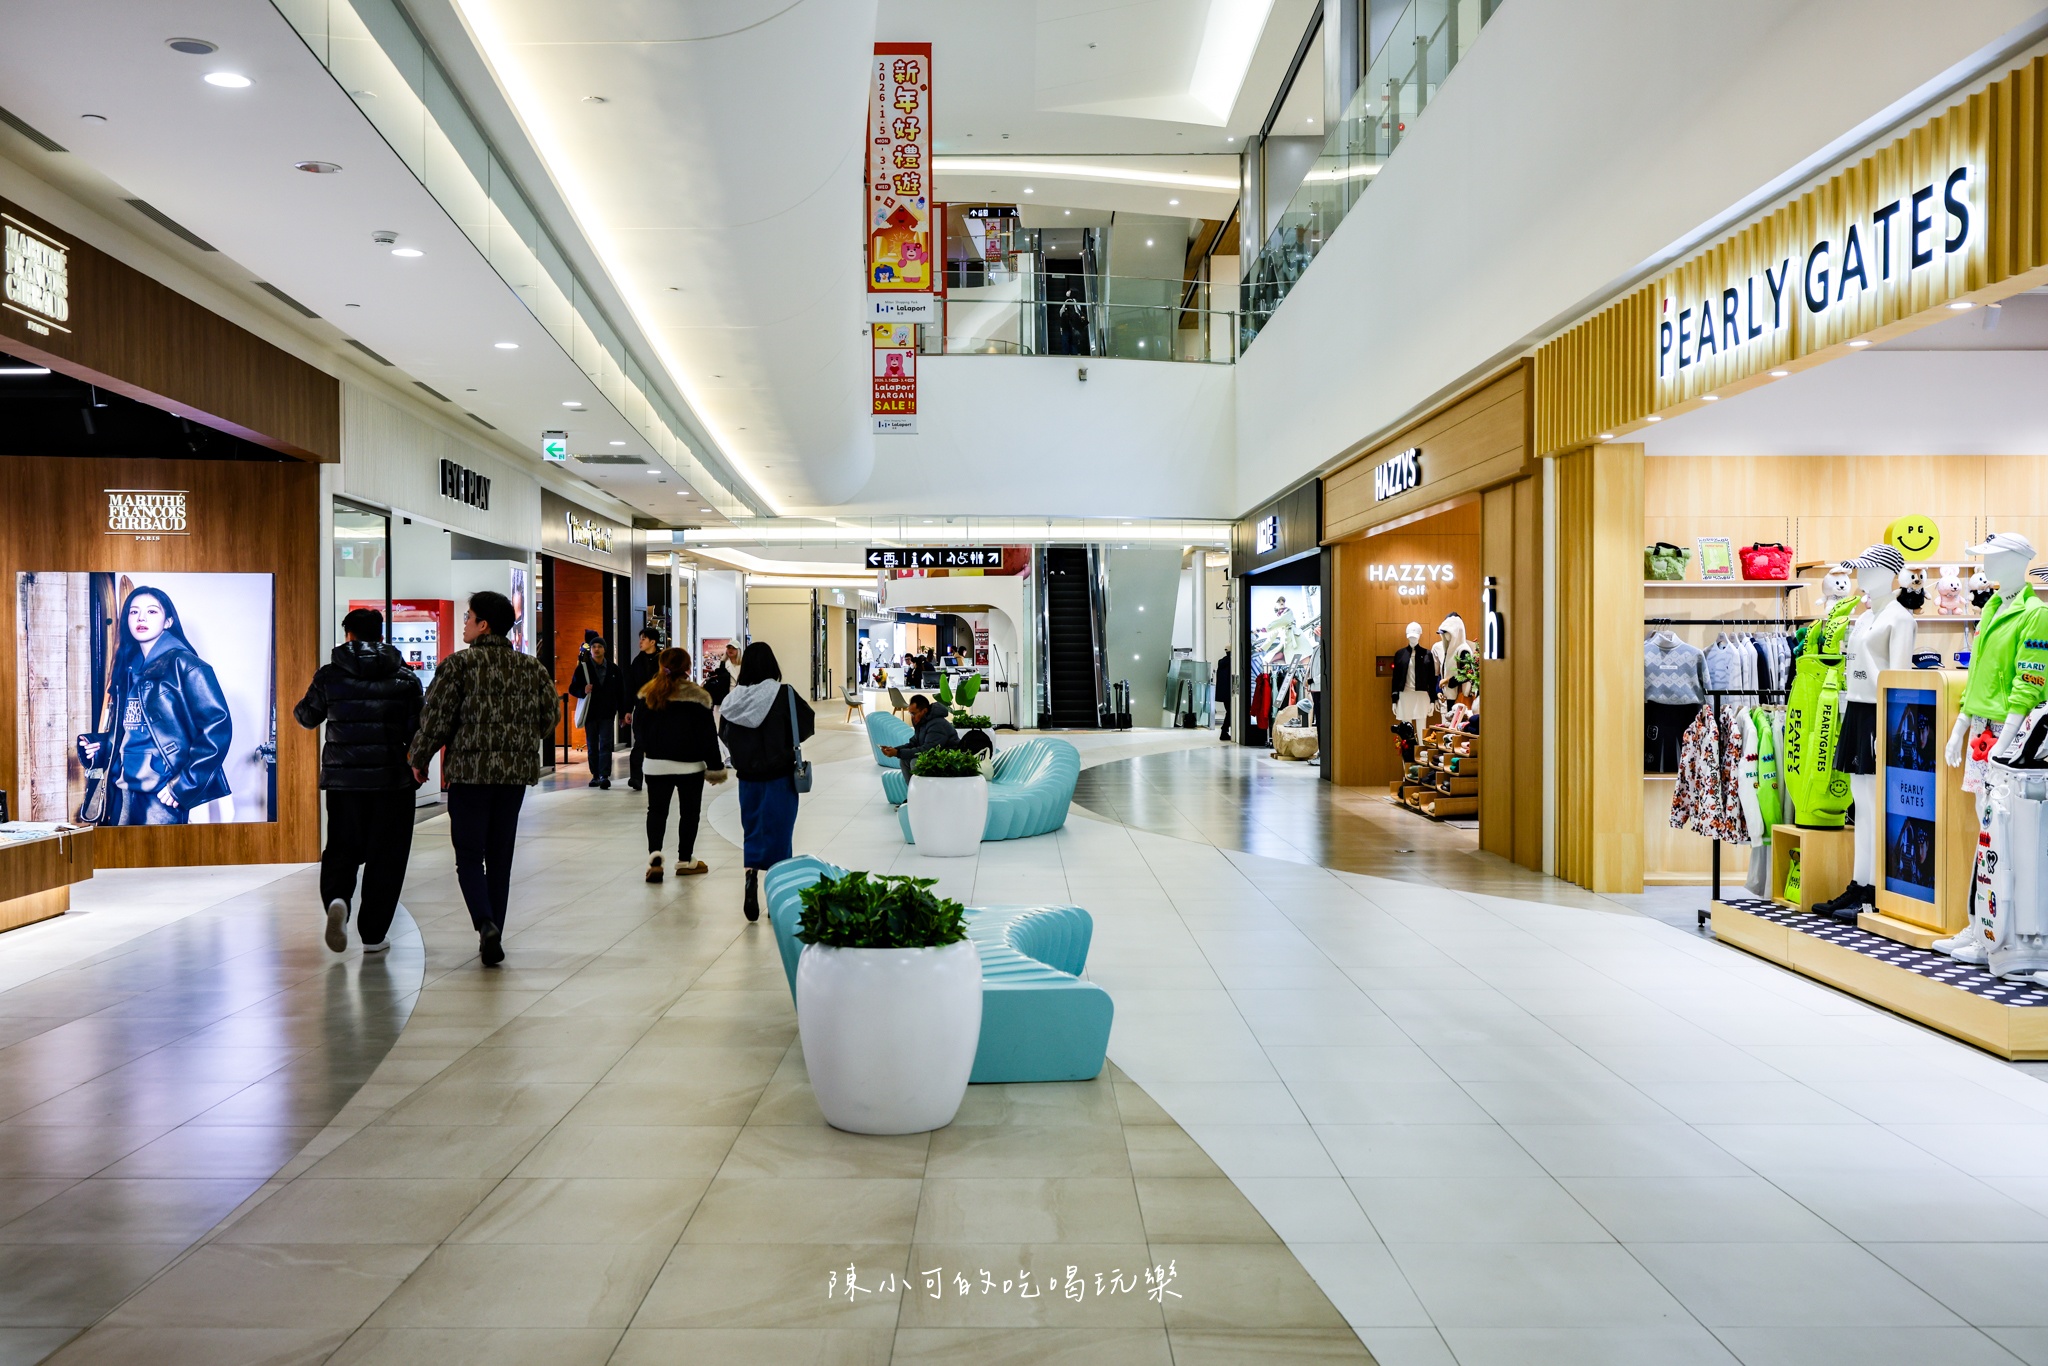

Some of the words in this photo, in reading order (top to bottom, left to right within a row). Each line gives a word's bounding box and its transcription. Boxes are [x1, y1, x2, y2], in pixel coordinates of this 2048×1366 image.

[892, 58, 921, 196] 新年好禮遊
[1660, 258, 1791, 378] PEARLY
[1804, 165, 1970, 314] GATES
[875, 400, 905, 410] SALE
[1375, 447, 1421, 502] HAZZYS
[440, 458, 464, 501] EYE
[463, 468, 491, 511] PLAY
[108, 493, 186, 506] MARITHÉ
[108, 517, 187, 531] GIRBAUD
[1369, 564, 1454, 581] HAZZYS
[1399, 585, 1426, 596] Golf
[2017, 662, 2046, 671] PEARLY
[1787, 707, 1796, 773] GATES
[1793, 709, 1802, 775] PEARLY
[1817, 704, 1832, 772] PEARLYGATES
[1901, 783, 1924, 795] PEARLY
[1901, 794, 1924, 807] GATES
